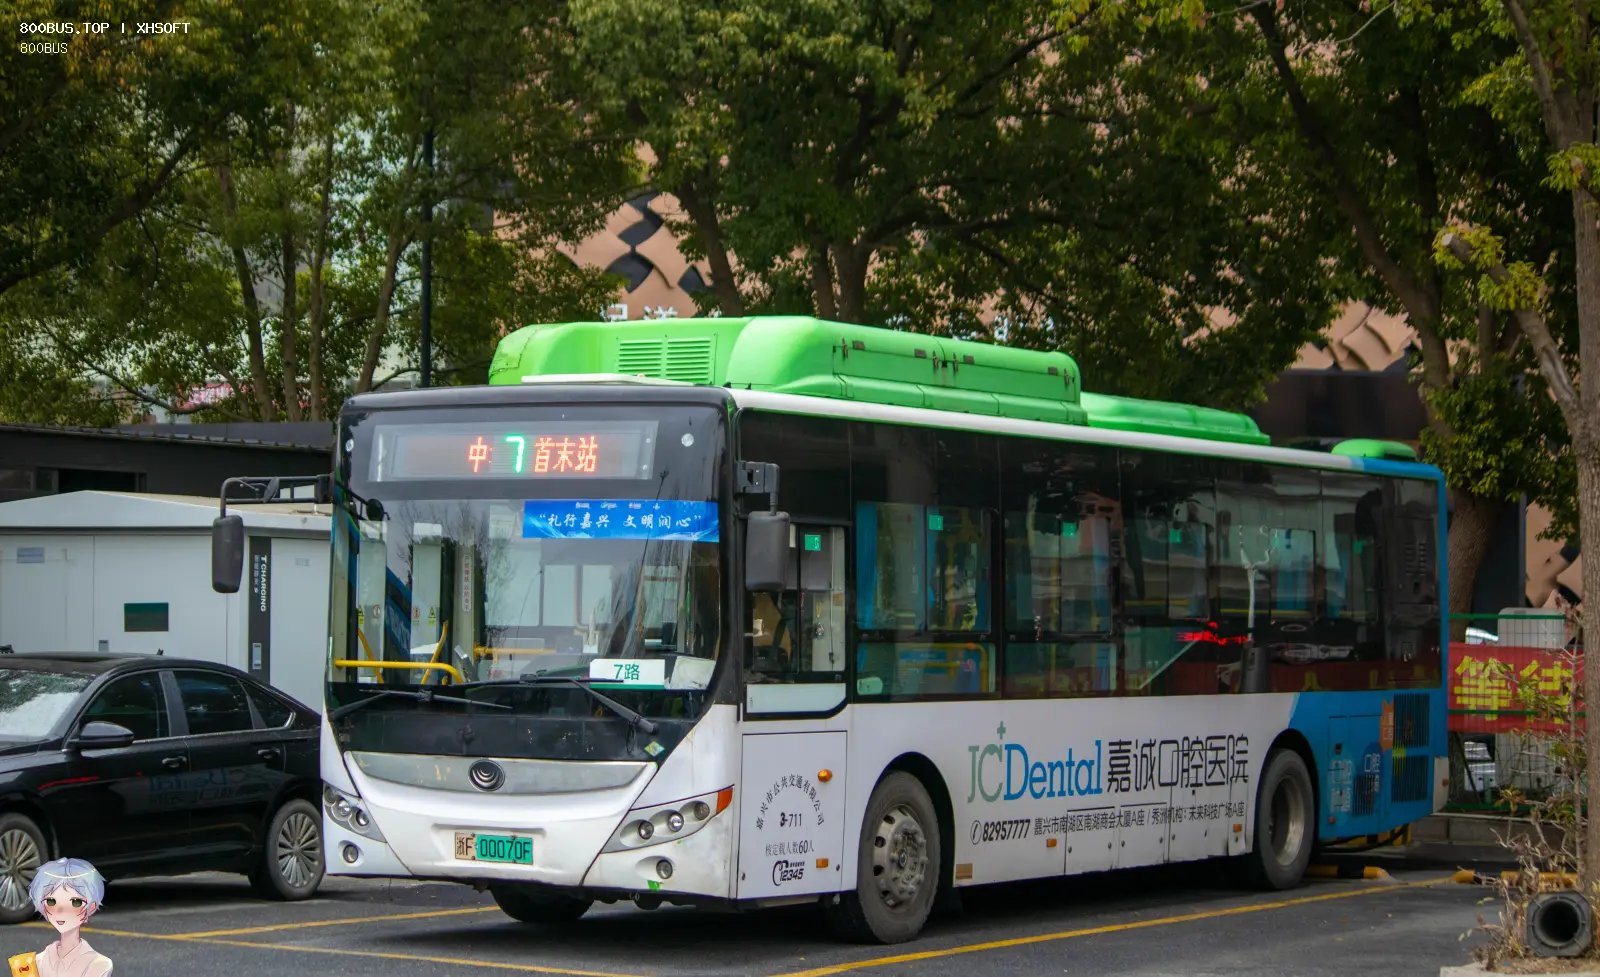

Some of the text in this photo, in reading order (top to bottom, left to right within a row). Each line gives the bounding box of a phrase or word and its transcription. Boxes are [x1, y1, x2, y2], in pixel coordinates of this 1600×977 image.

[467, 434, 598, 473] 中 7 首末站
[613, 663, 640, 681] 7路
[1106, 733, 1249, 793] 嘉诚口腔医院
[779, 811, 803, 828] 3-711
[982, 818, 1032, 842] 82957777
[779, 867, 804, 882] 12345
